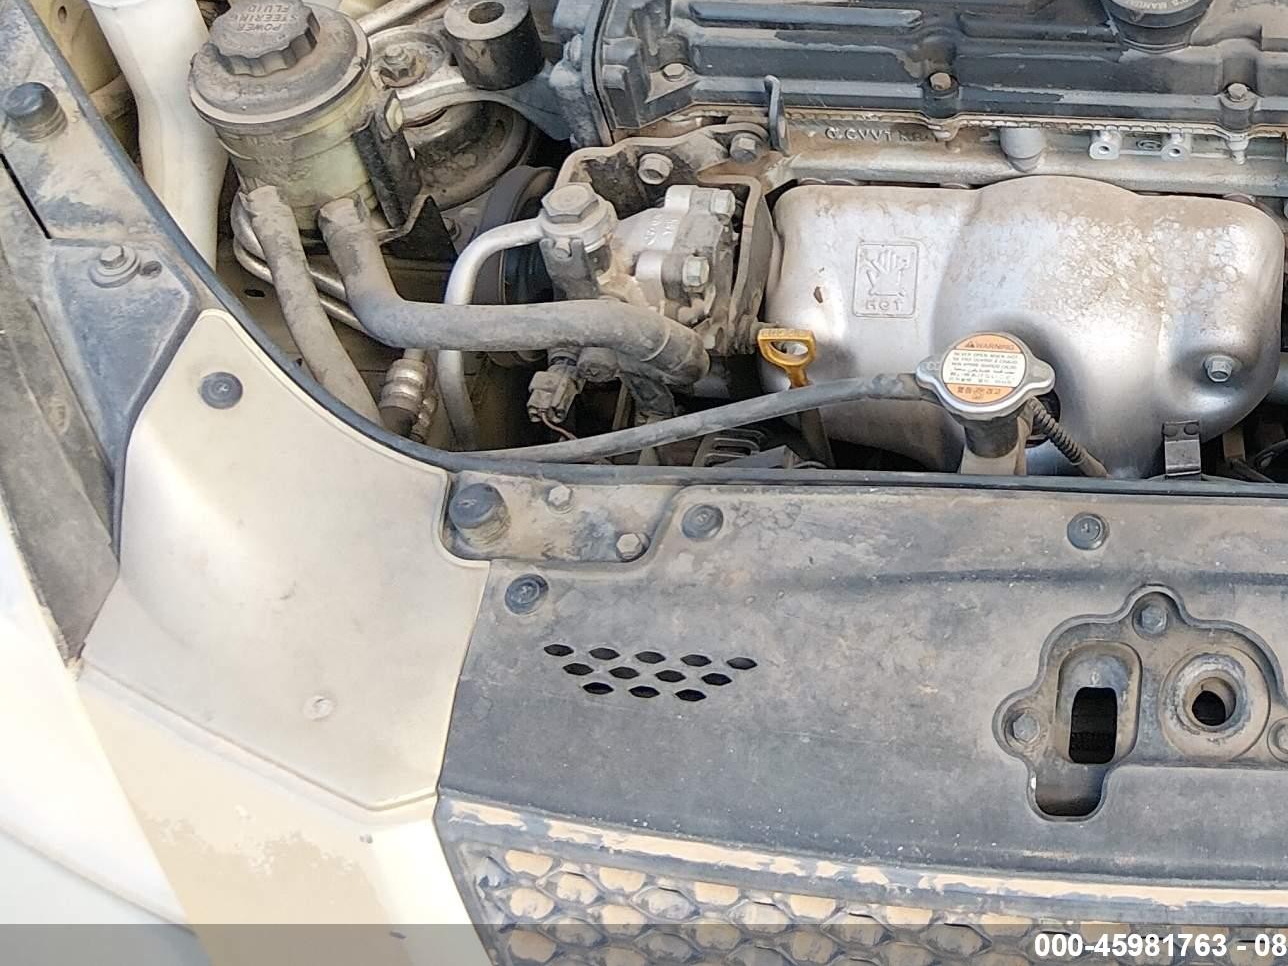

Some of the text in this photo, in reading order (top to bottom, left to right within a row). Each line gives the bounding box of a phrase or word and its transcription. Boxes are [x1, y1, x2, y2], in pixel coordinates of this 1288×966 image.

[246, 3, 290, 14] FLUID
[236, 22, 281, 32] POWER
[976, 342, 1015, 350] WARNING
